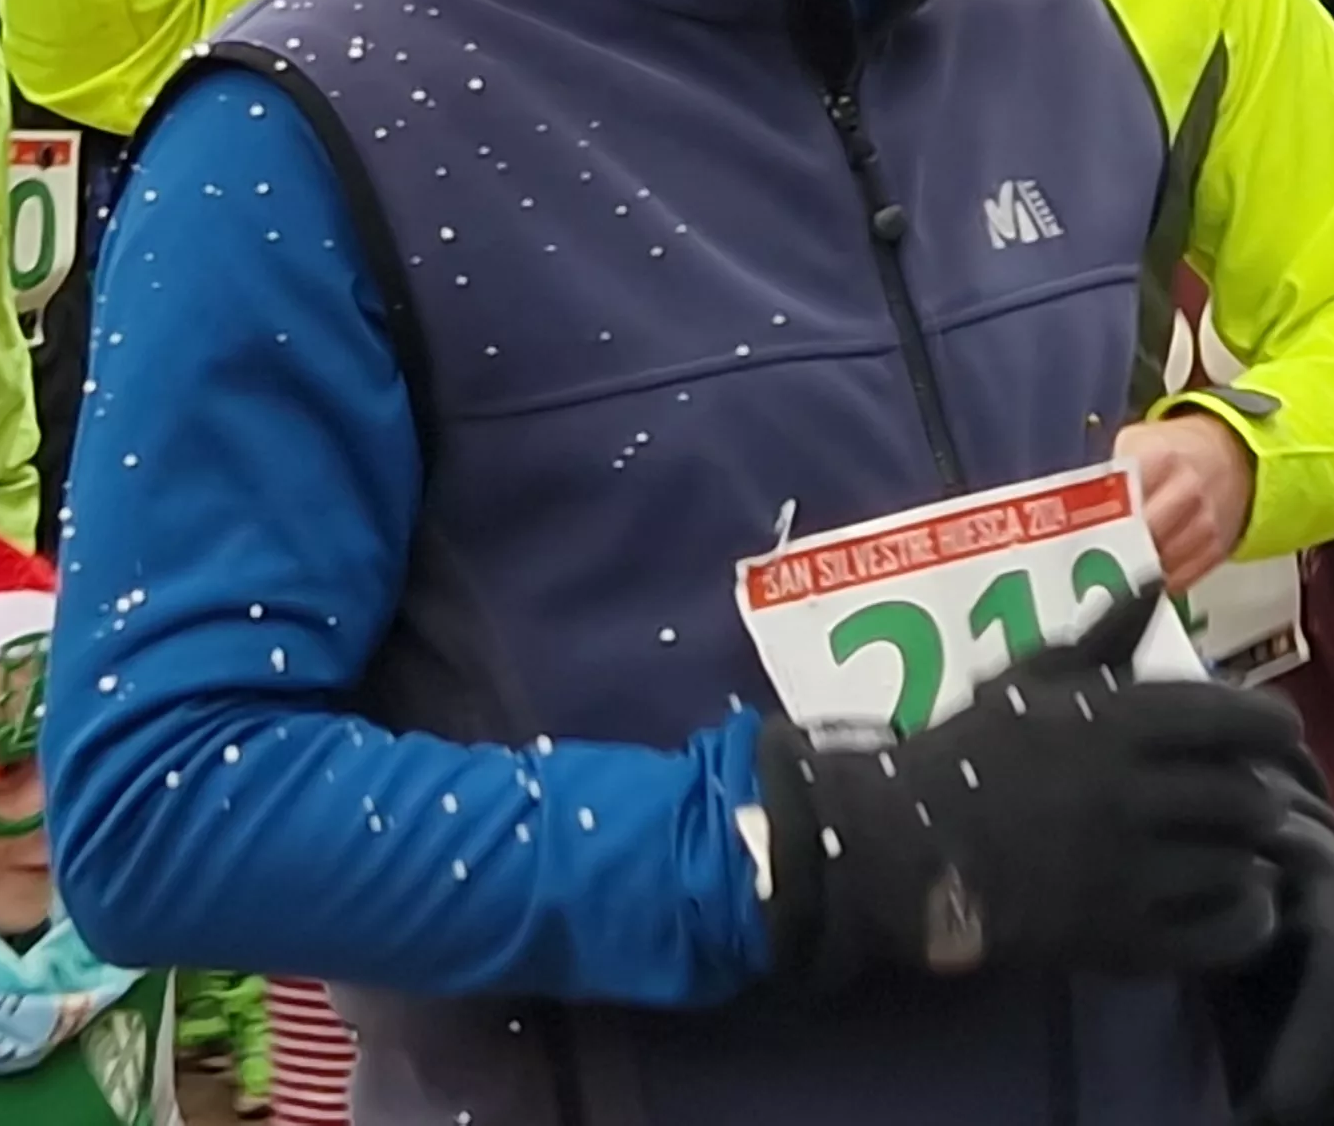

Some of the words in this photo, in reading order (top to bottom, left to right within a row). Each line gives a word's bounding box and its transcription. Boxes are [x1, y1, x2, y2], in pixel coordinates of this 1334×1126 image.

[762, 556, 814, 601] SAN
[814, 527, 938, 587] SILVESTRE
[935, 505, 1025, 558] HUESCA
